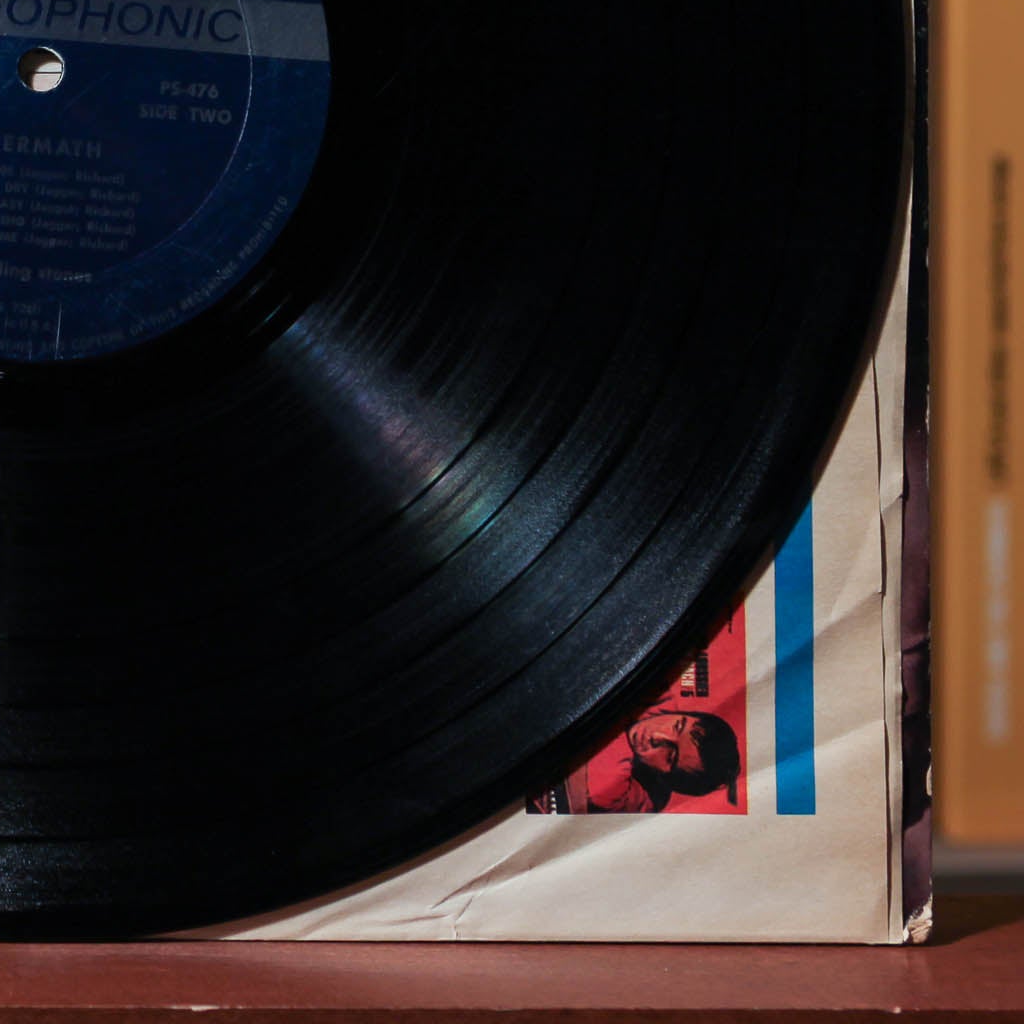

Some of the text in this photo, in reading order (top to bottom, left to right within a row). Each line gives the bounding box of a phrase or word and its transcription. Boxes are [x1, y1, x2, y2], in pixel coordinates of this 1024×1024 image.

[159, 79, 221, 100] PS-476
[137, 103, 233, 126] SIDE TWO
